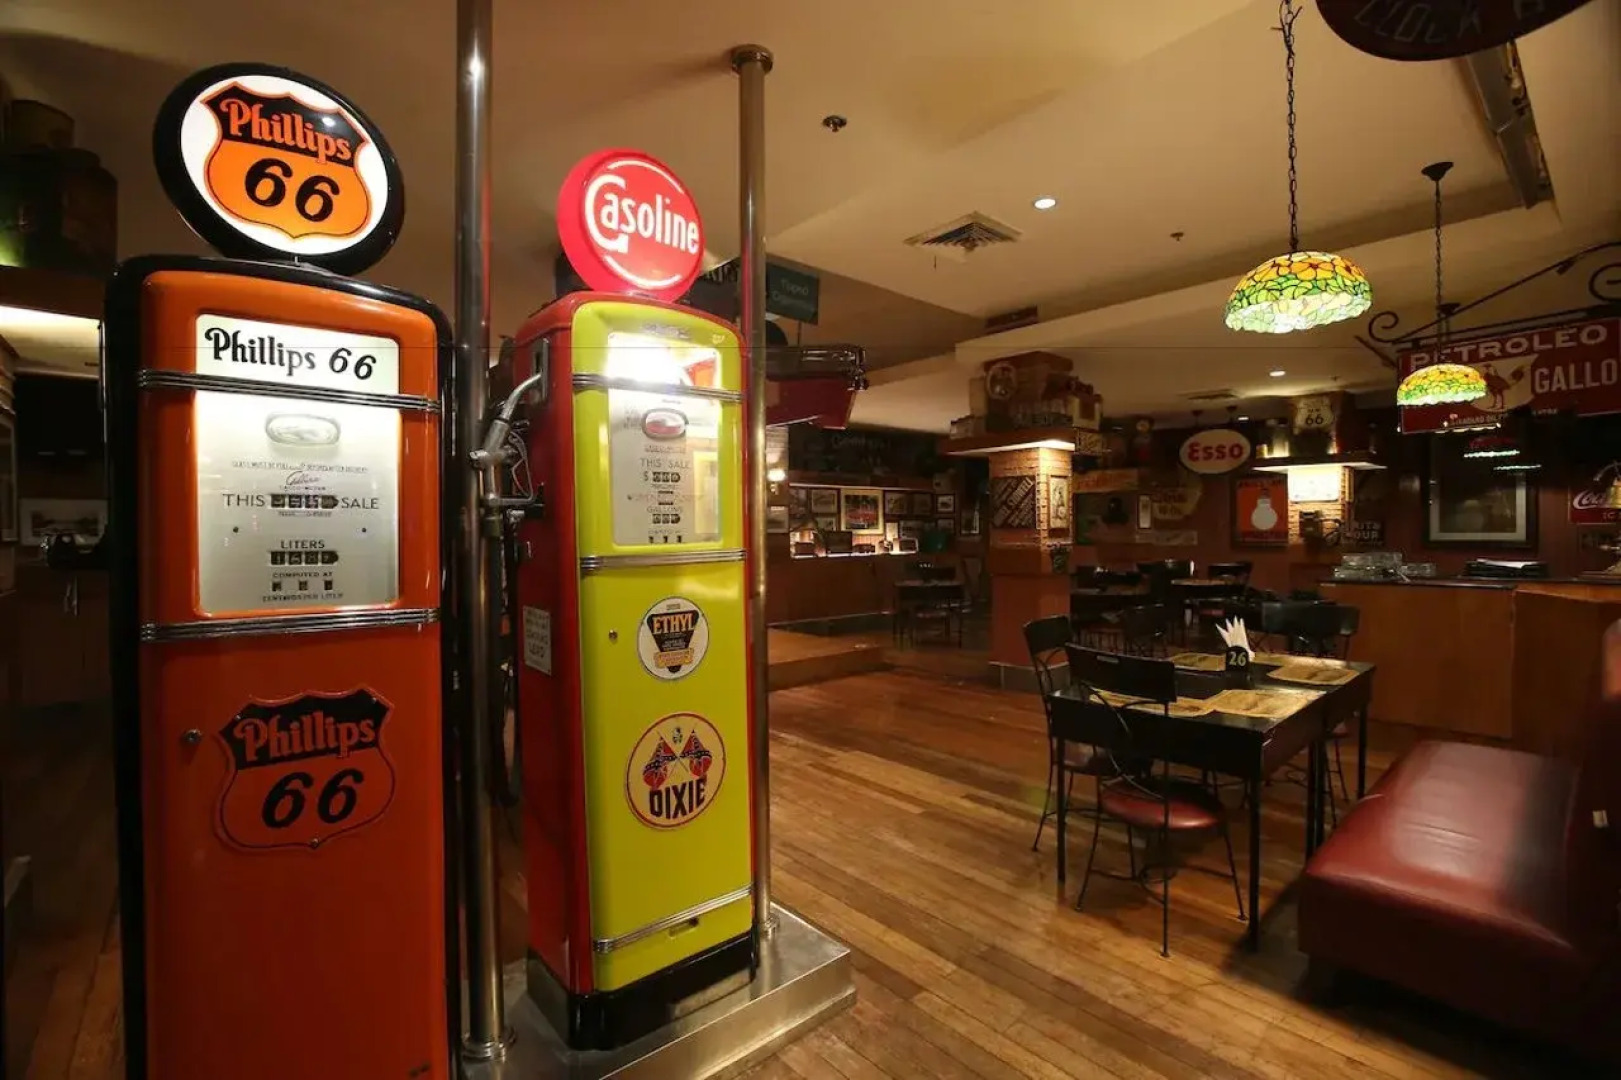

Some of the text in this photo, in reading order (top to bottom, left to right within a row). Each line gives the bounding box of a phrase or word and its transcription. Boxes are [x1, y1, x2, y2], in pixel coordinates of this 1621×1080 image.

[220, 99, 351, 164] Phillips
[245, 158, 340, 222] 66
[585, 174, 699, 254] Gasoline
[204, 327, 377, 380] Phillips 66
[1534, 358, 1618, 394] GALLO
[1305, 413, 1324, 425] 66
[640, 457, 662, 468] THIS
[222, 493, 266, 507] THIS
[341, 496, 379, 510] SALE
[281, 540, 325, 549] LITERS
[652, 613, 695, 634] ETHYL
[1230, 651, 1247, 667] 26
[233, 710, 376, 762] Phillips
[262, 768, 363, 829] 66
[649, 780, 707, 819] DIXIE
